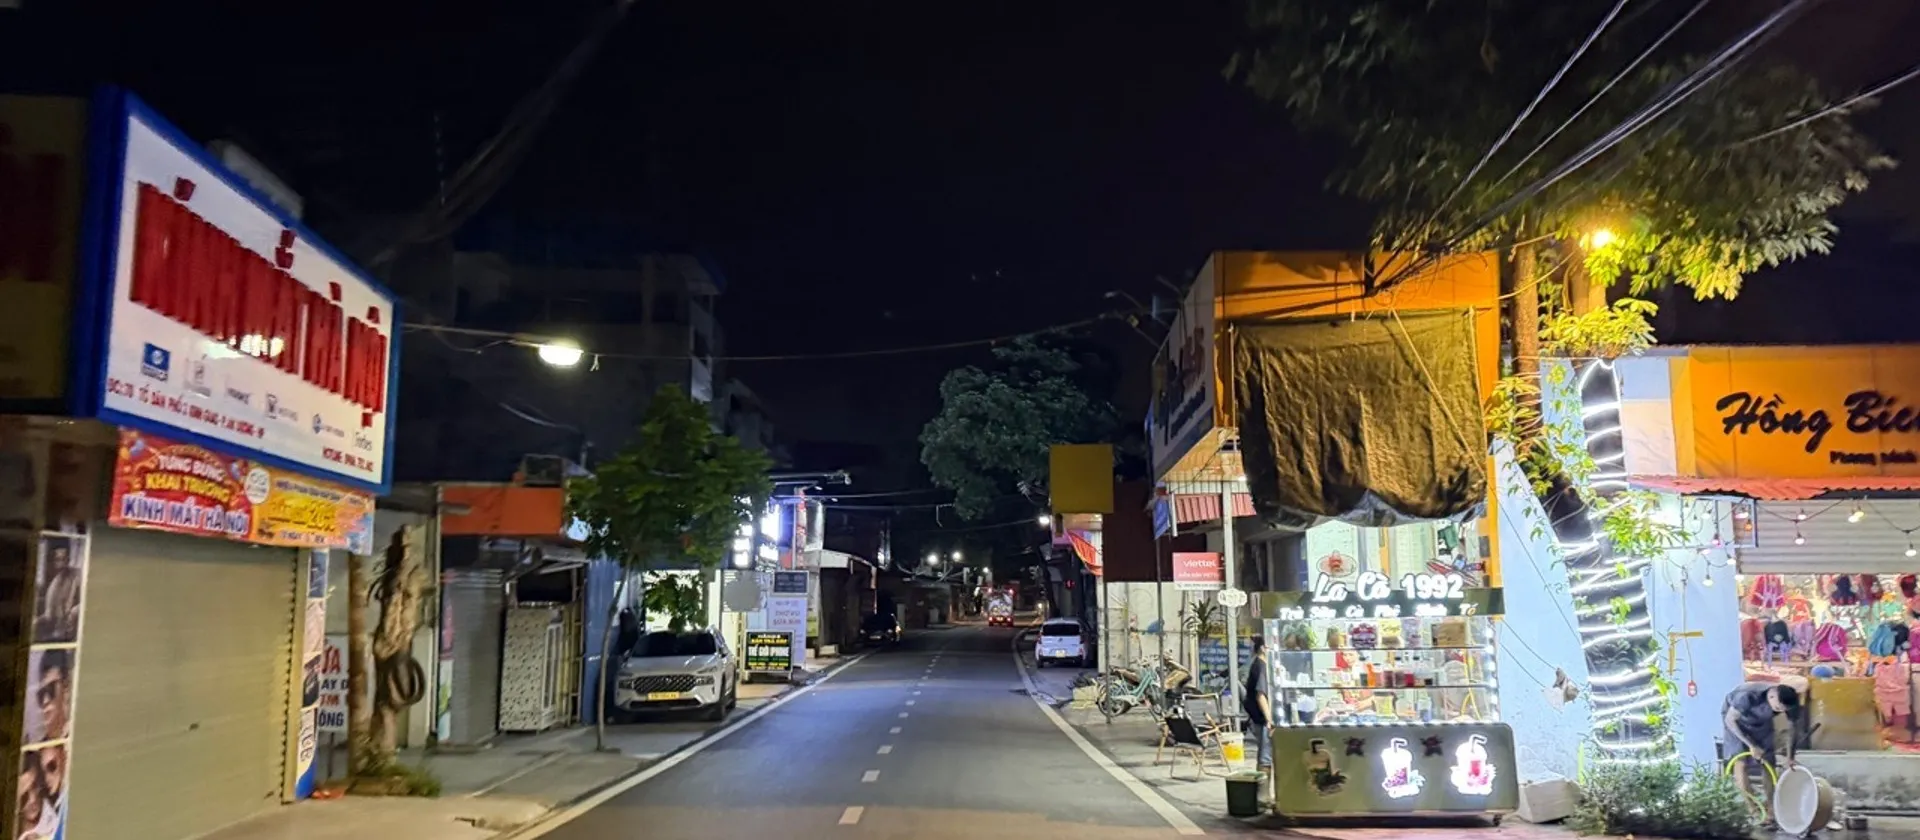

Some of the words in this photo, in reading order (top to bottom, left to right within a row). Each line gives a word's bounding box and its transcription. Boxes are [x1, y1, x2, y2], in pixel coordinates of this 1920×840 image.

[343, 305, 387, 428] NỘI
[1716, 391, 1832, 453] Hồng
[146, 472, 181, 491] KHAI
[183, 476, 231, 503] TRƯƠNG
[122, 490, 166, 524] KÍNH
[170, 496, 202, 528] MẮT
[205, 504, 224, 531] HÀ
[226, 506, 250, 536] NỘI
[1183, 559, 1217, 569] viettel
[1400, 572, 1465, 600] 1992
